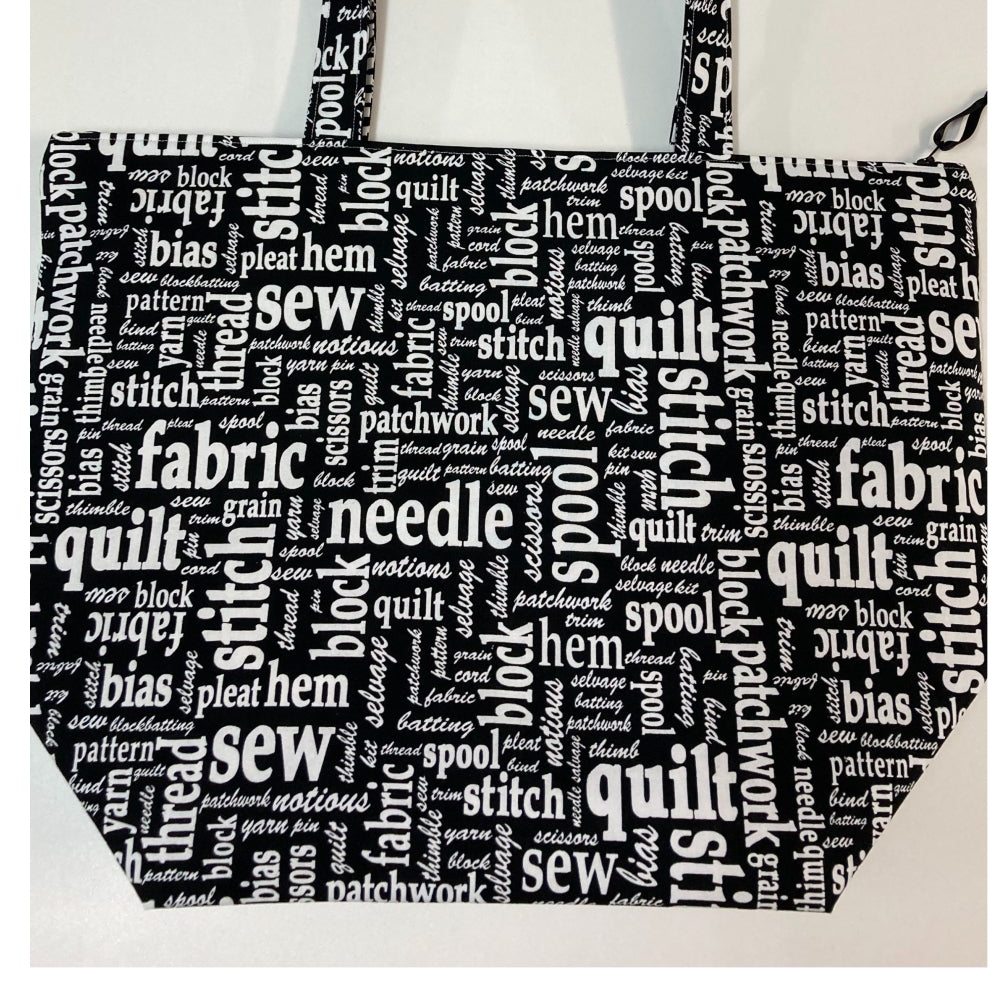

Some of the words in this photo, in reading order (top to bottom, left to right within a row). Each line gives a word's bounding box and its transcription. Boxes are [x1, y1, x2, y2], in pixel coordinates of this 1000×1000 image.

[219, 151, 255, 160] cord
[339, 147, 392, 233] block
[396, 174, 459, 208] quilt
[520, 175, 607, 194] patchwork
[620, 177, 703, 221] spool
[543, 196, 618, 239] hem
[150, 229, 217, 268] bias
[240, 243, 298, 278] pleat
[301, 232, 376, 272] hem
[489, 203, 538, 287] block
[40, 202, 92, 369] patchwork
[256, 285, 365, 331] sew
[443, 290, 509, 330] spool
[159, 316, 192, 368] yarn
[200, 291, 253, 391] thread
[391, 318, 435, 398] fabric
[478, 324, 565, 361] stitch
[584, 296, 719, 377] quilt
[110, 371, 199, 408] stitch
[529, 385, 612, 422] sew
[802, 389, 890, 427] stitch
[359, 401, 498, 446] patchwork
[538, 425, 594, 441] needle
[658, 368, 735, 510] stitch
[135, 419, 307, 490] fabric
[362, 439, 399, 494] trim
[490, 456, 551, 483] batting
[836, 436, 985, 515] fabric
[66, 500, 130, 515] thimble
[222, 491, 281, 527] grain
[326, 479, 514, 549] needle
[530, 447, 621, 584] spool
[54, 506, 188, 591] quilt
[927, 516, 977, 549] grain
[768, 523, 893, 606] quilt
[135, 581, 194, 608] block
[197, 524, 276, 670] stitch
[309, 554, 370, 660] block
[718, 548, 763, 637] block
[101, 660, 172, 707] bias
[195, 674, 261, 718] pleat
[264, 659, 349, 707] hem
[841, 678, 911, 725] bias
[209, 725, 335, 783] sew
[424, 728, 500, 779] spool
[139, 736, 207, 863] thread
[362, 764, 414, 866] fabric
[464, 772, 565, 819] stitch
[585, 743, 738, 842] quilt
[522, 849, 618, 894] sew
